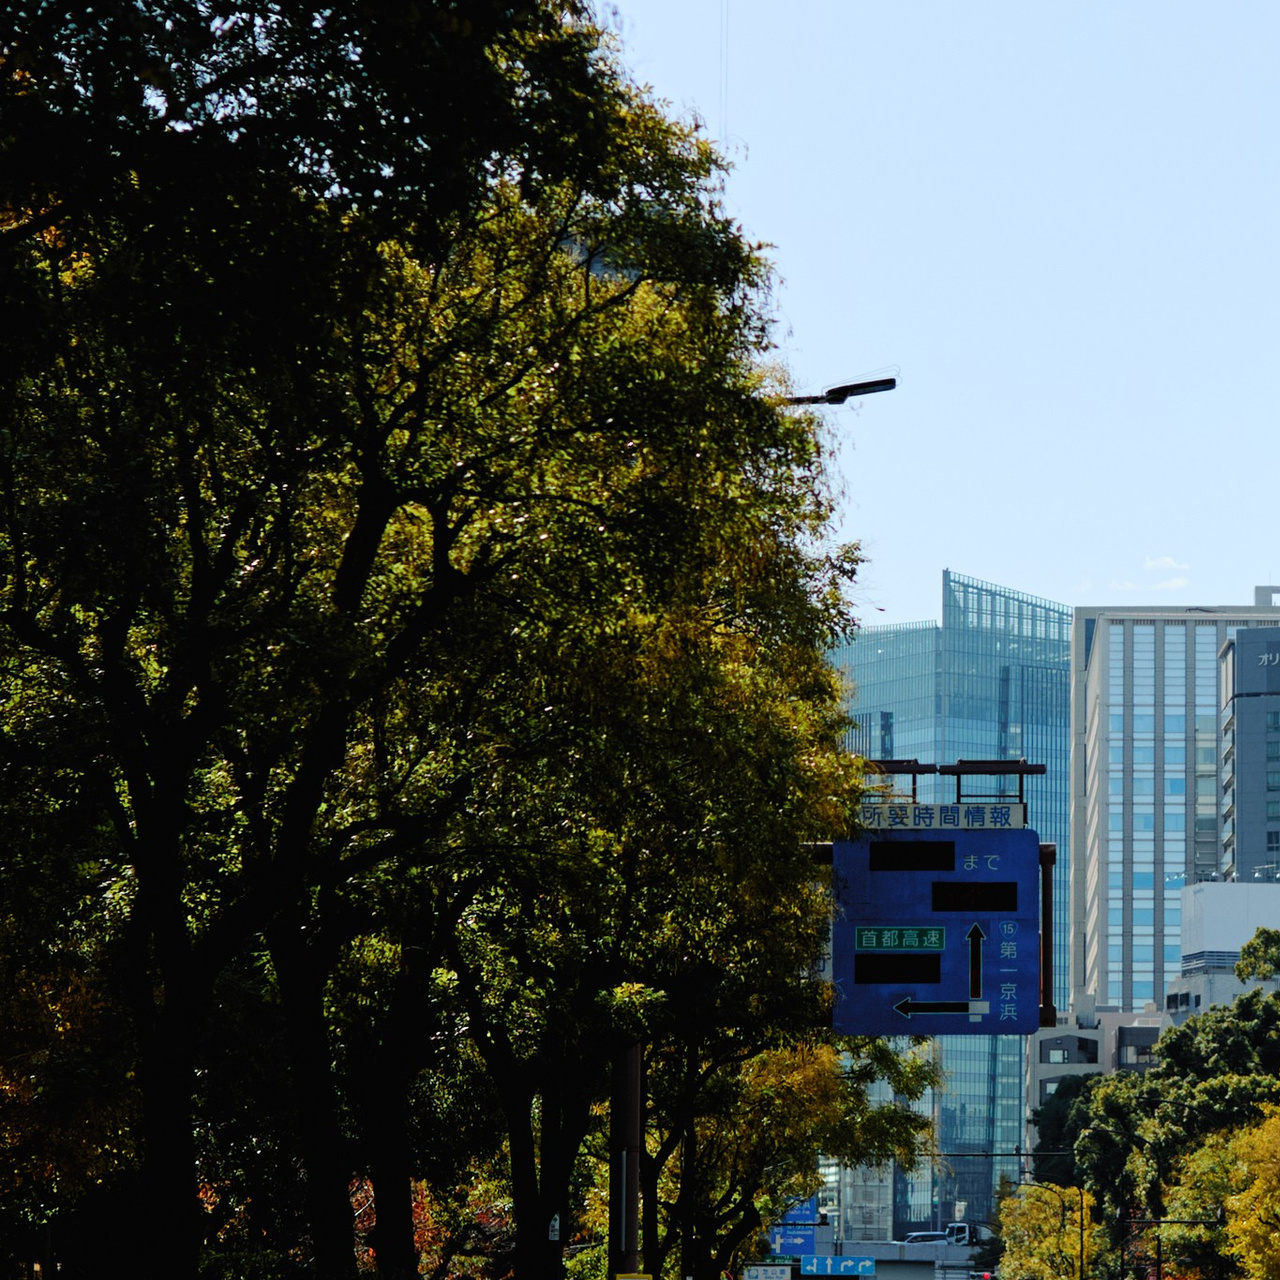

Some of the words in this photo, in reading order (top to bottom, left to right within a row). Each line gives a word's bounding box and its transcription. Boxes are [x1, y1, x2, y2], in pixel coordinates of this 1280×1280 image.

[862, 805, 1012, 827] 所要時間情報
[963, 854, 1000, 871] まで
[1002, 923, 1015, 934] 15
[860, 930, 942, 947] 首都高速
[999, 941, 1018, 1021] 第一京浜
